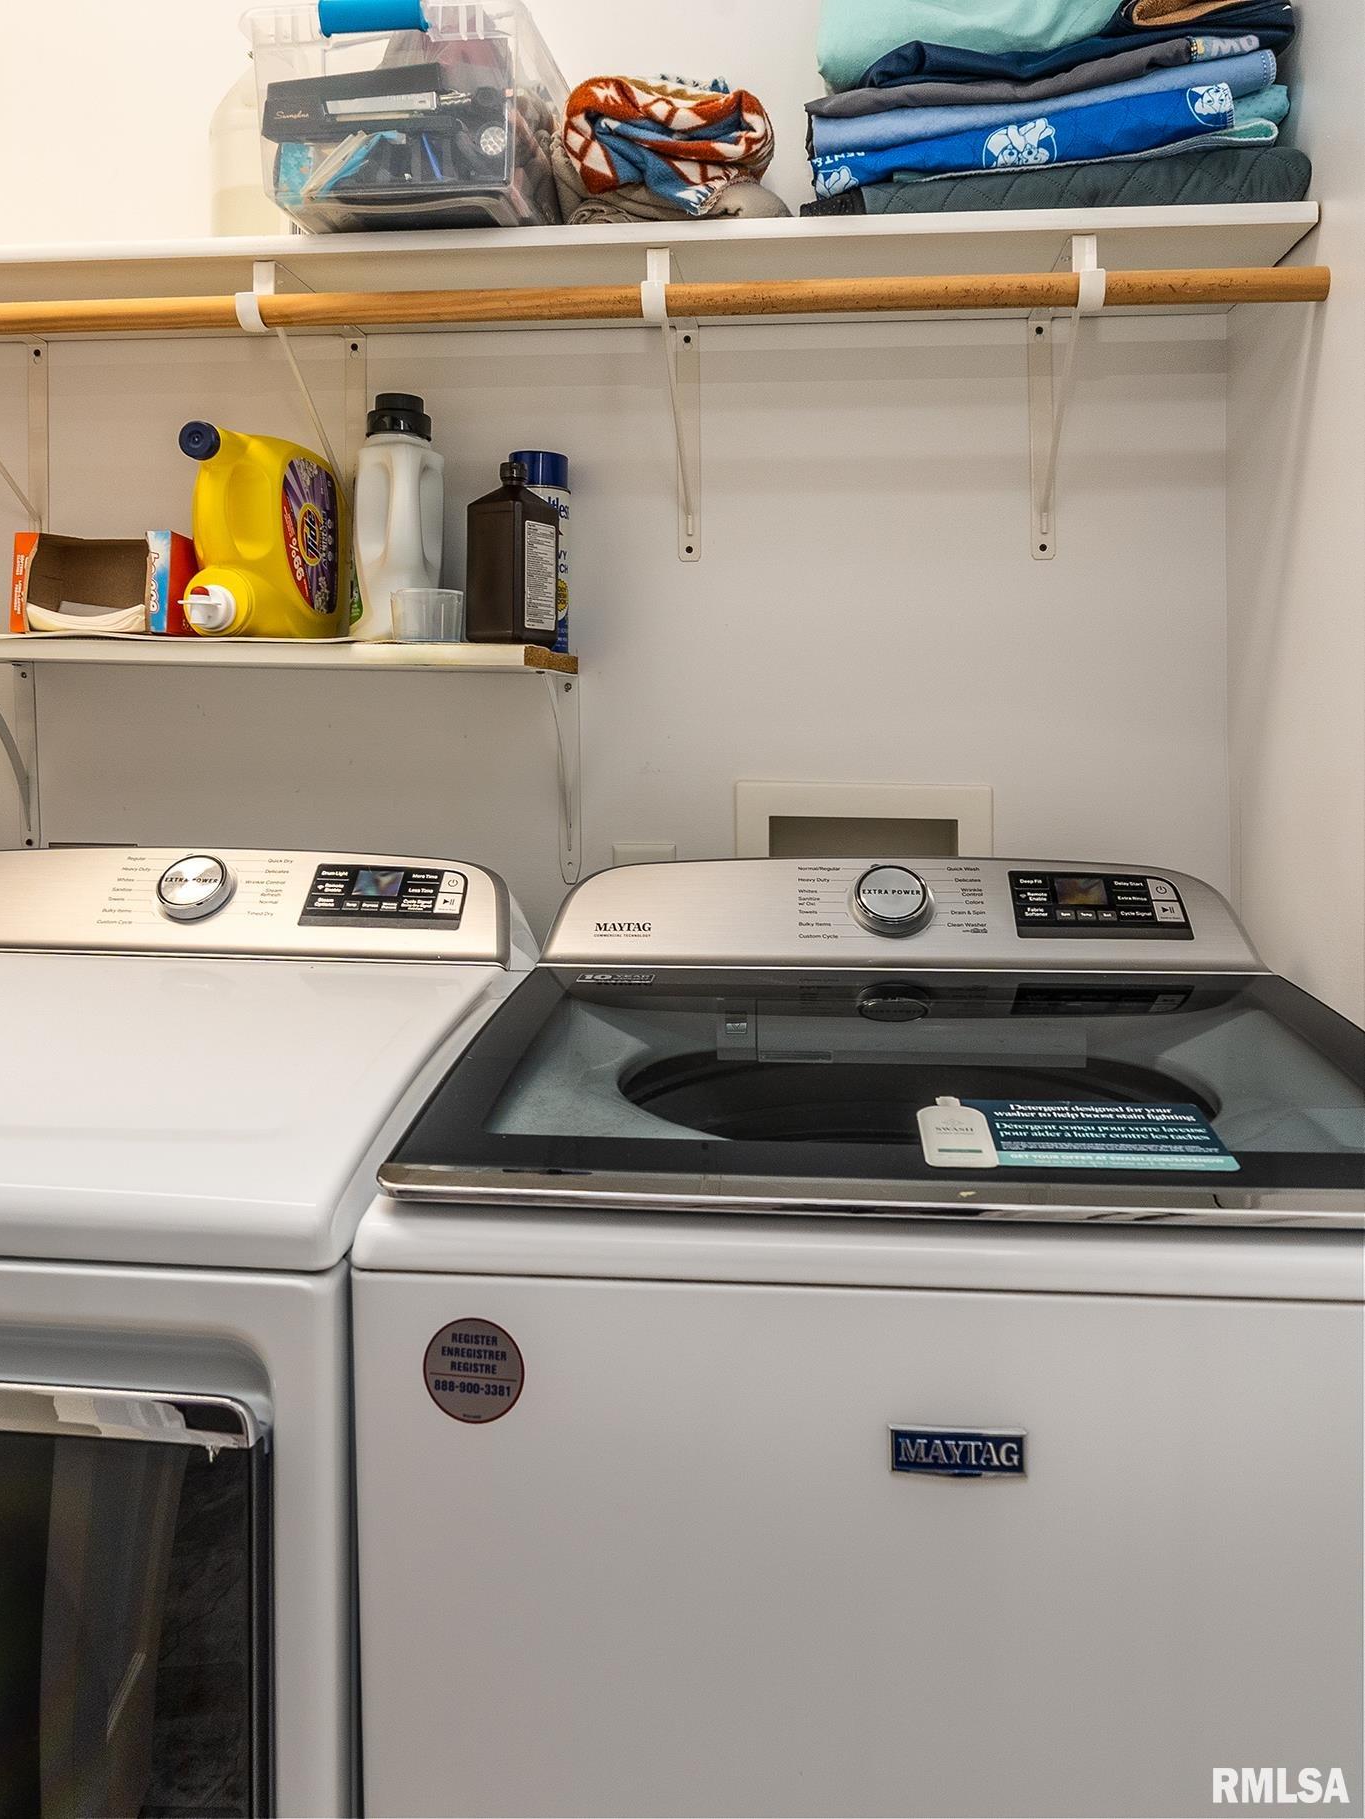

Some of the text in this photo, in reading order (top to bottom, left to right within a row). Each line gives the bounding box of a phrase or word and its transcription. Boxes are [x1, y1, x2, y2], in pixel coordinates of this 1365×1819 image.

[304, 511, 320, 559] Tide
[289, 537, 305, 581] 99%
[594, 922, 652, 932] MAYTAG
[1009, 1104, 1070, 1112] Detergent
[1071, 1105, 1124, 1113] designed
[1052, 1112, 1079, 1120] help
[1146, 1114, 1196, 1122] fighting
[451, 1332, 498, 1346] REGISTER
[441, 1346, 507, 1361] ENREGISTRER
[450, 1361, 498, 1375] REGISTRE
[434, 1379, 511, 1397] 888-900-3381
[898, 1438, 1020, 1467] MAYTAG
